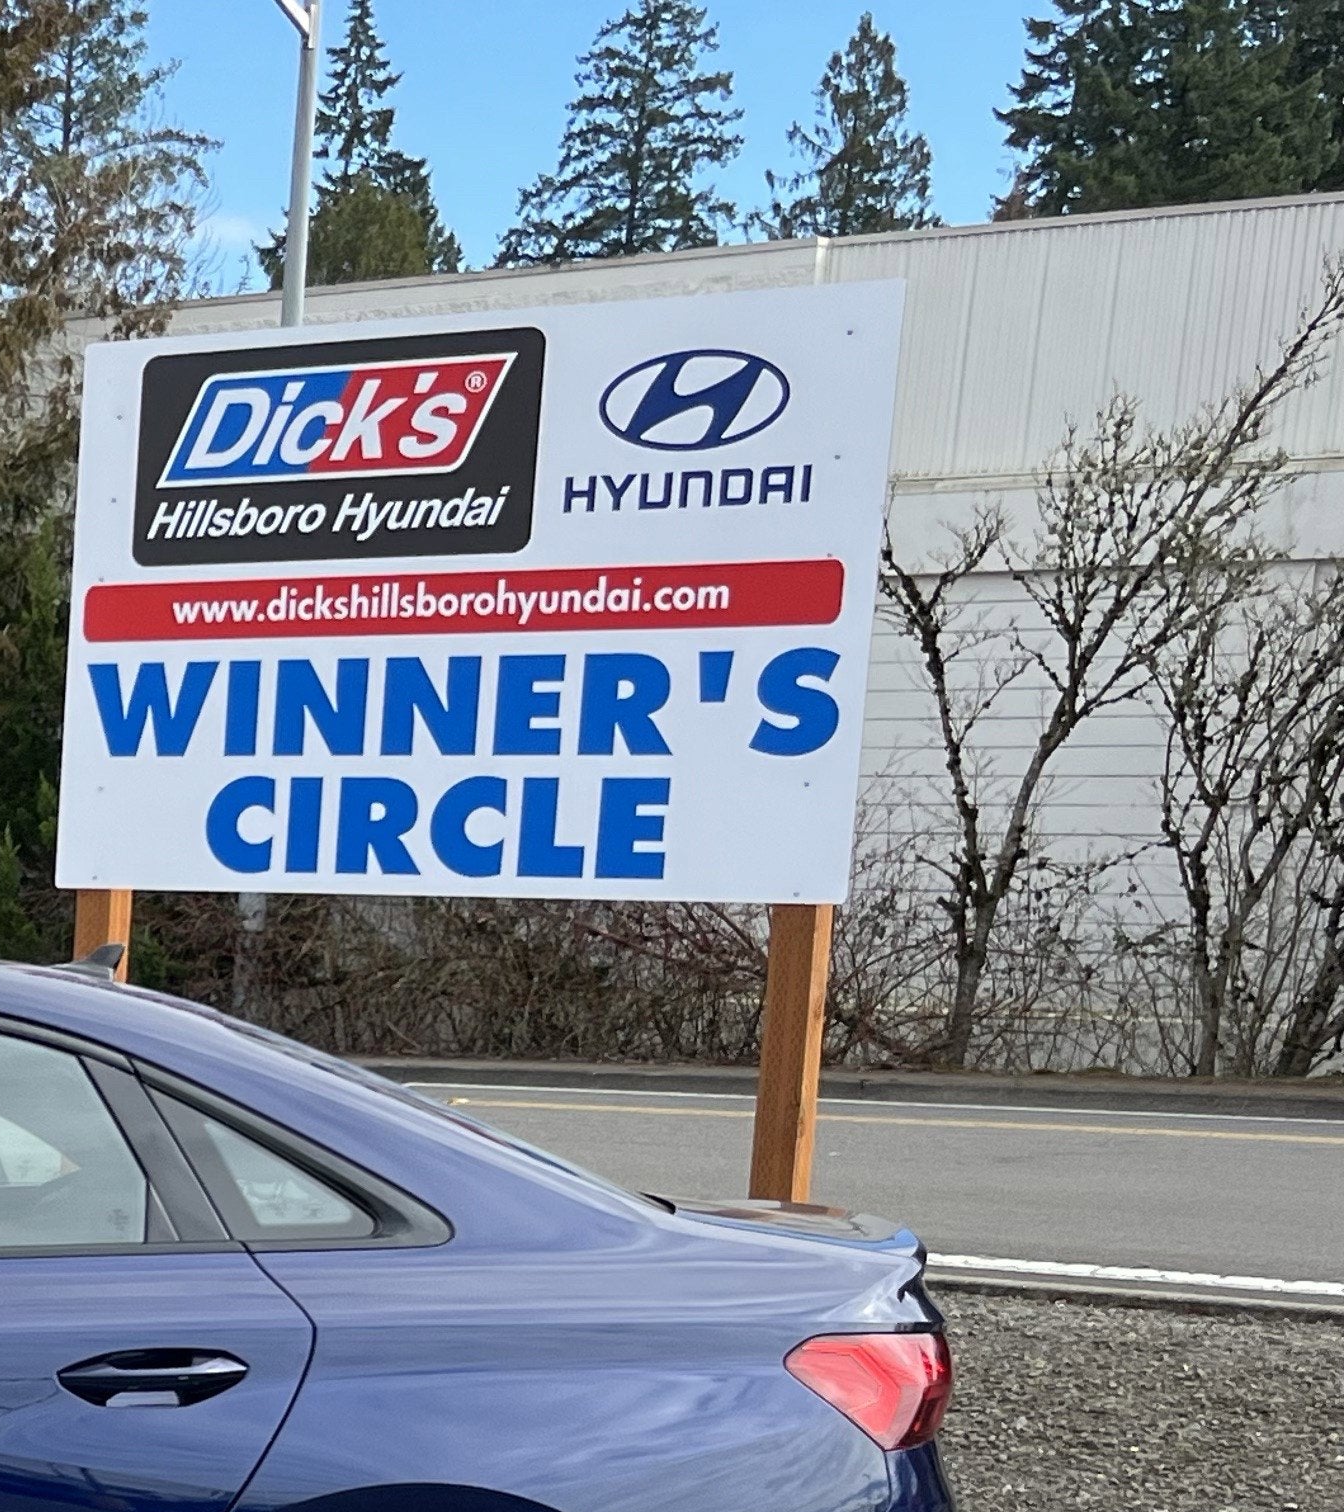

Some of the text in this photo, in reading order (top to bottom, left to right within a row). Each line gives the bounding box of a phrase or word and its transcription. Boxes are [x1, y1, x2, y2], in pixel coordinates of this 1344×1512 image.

[146, 486, 511, 541] Hillsboro Hyundai
[563, 464, 812, 513] HYUNDAI
[173, 576, 730, 624] www.dickshillsborohyundai.com
[87, 647, 841, 757] WINNER'S
[206, 776, 672, 881] CIRCLE
